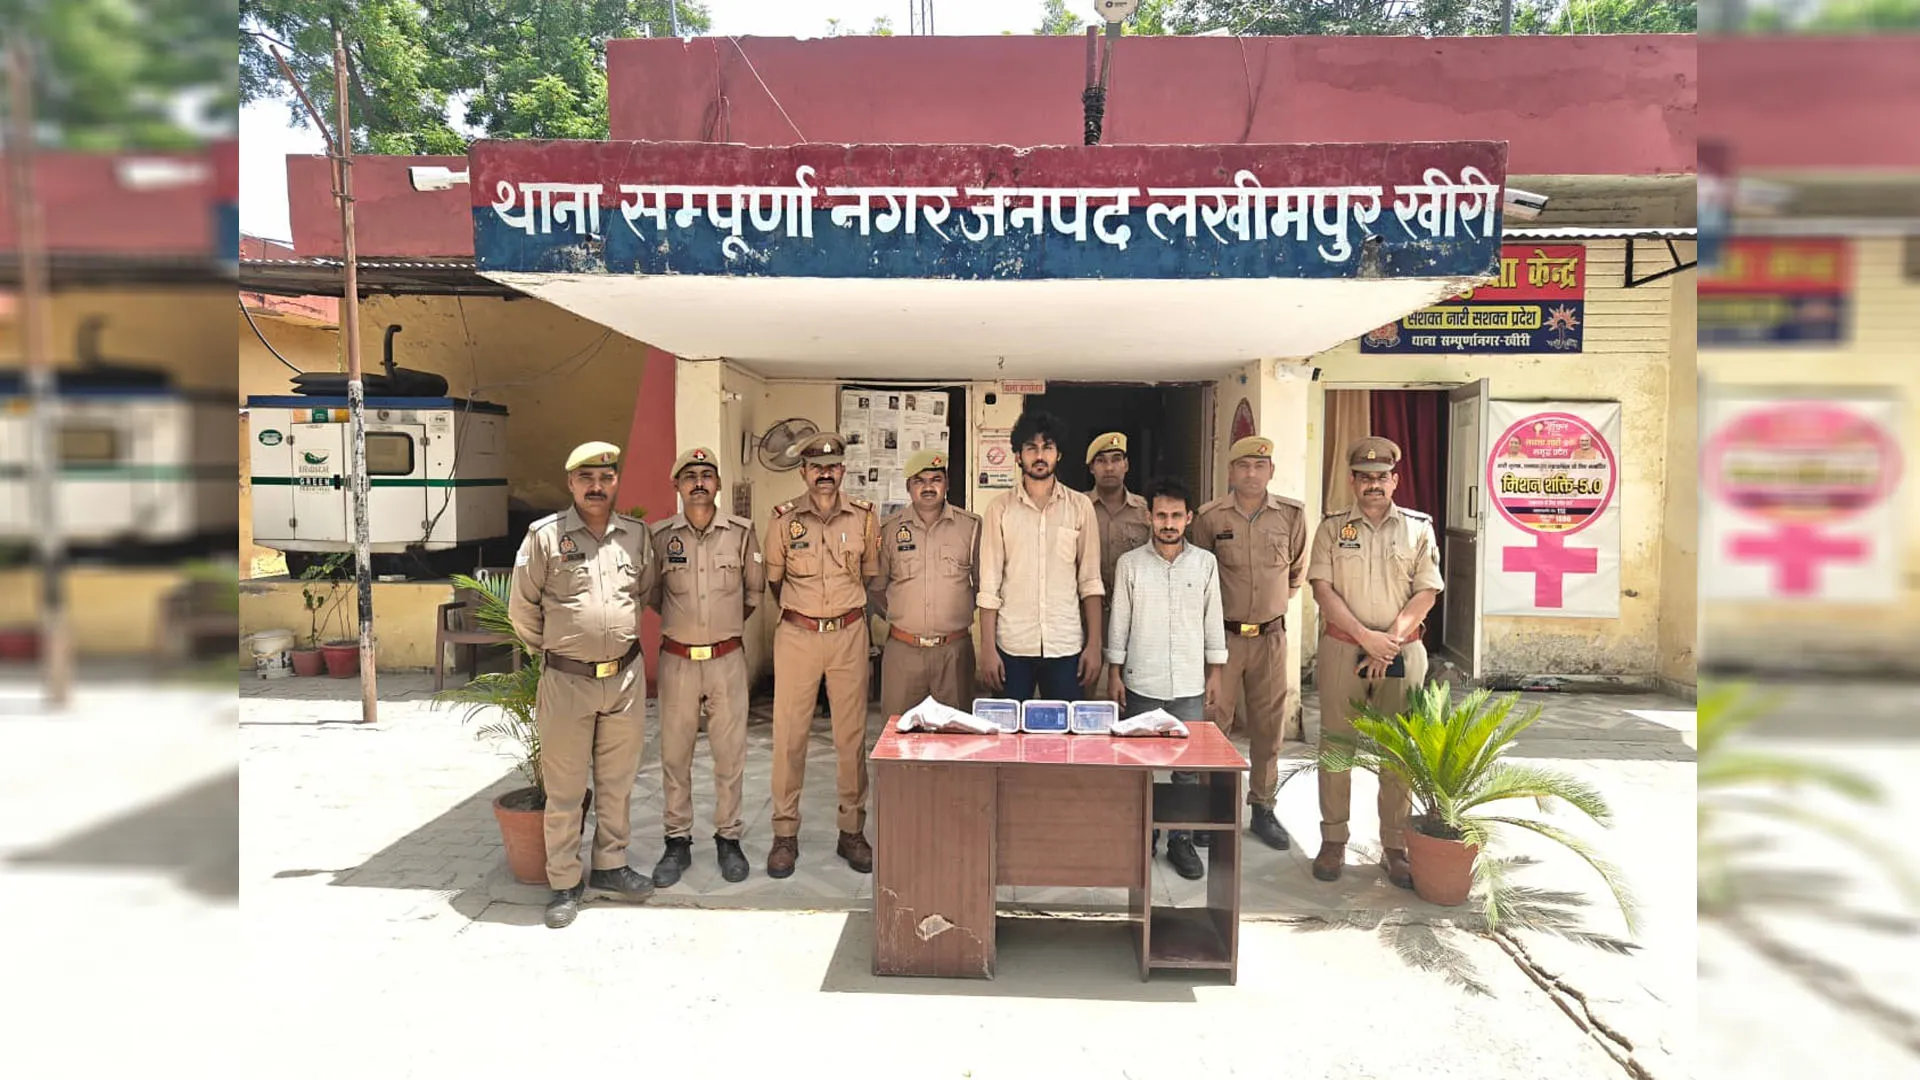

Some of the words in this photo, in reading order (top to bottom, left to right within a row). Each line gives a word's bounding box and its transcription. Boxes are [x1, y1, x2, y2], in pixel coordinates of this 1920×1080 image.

[492, 180, 603, 236] थाना
[619, 165, 817, 259] सम्पूर्णा
[825, 187, 960, 242] नगर
[958, 187, 1141, 251] जनपद
[1146, 169, 1383, 262] लखीमपुर
[1393, 166, 1500, 240] खीरी
[1526, 248, 1578, 289] केन्द्र
[1446, 306, 1469, 326] नारी
[1472, 311, 1508, 326] सशक्त
[1512, 306, 1536, 327] प्रदेश
[1411, 335, 1436, 347] थाना
[1501, 472, 1541, 493] मिशन
[1543, 472, 1603, 494] शक्ति-5.0
